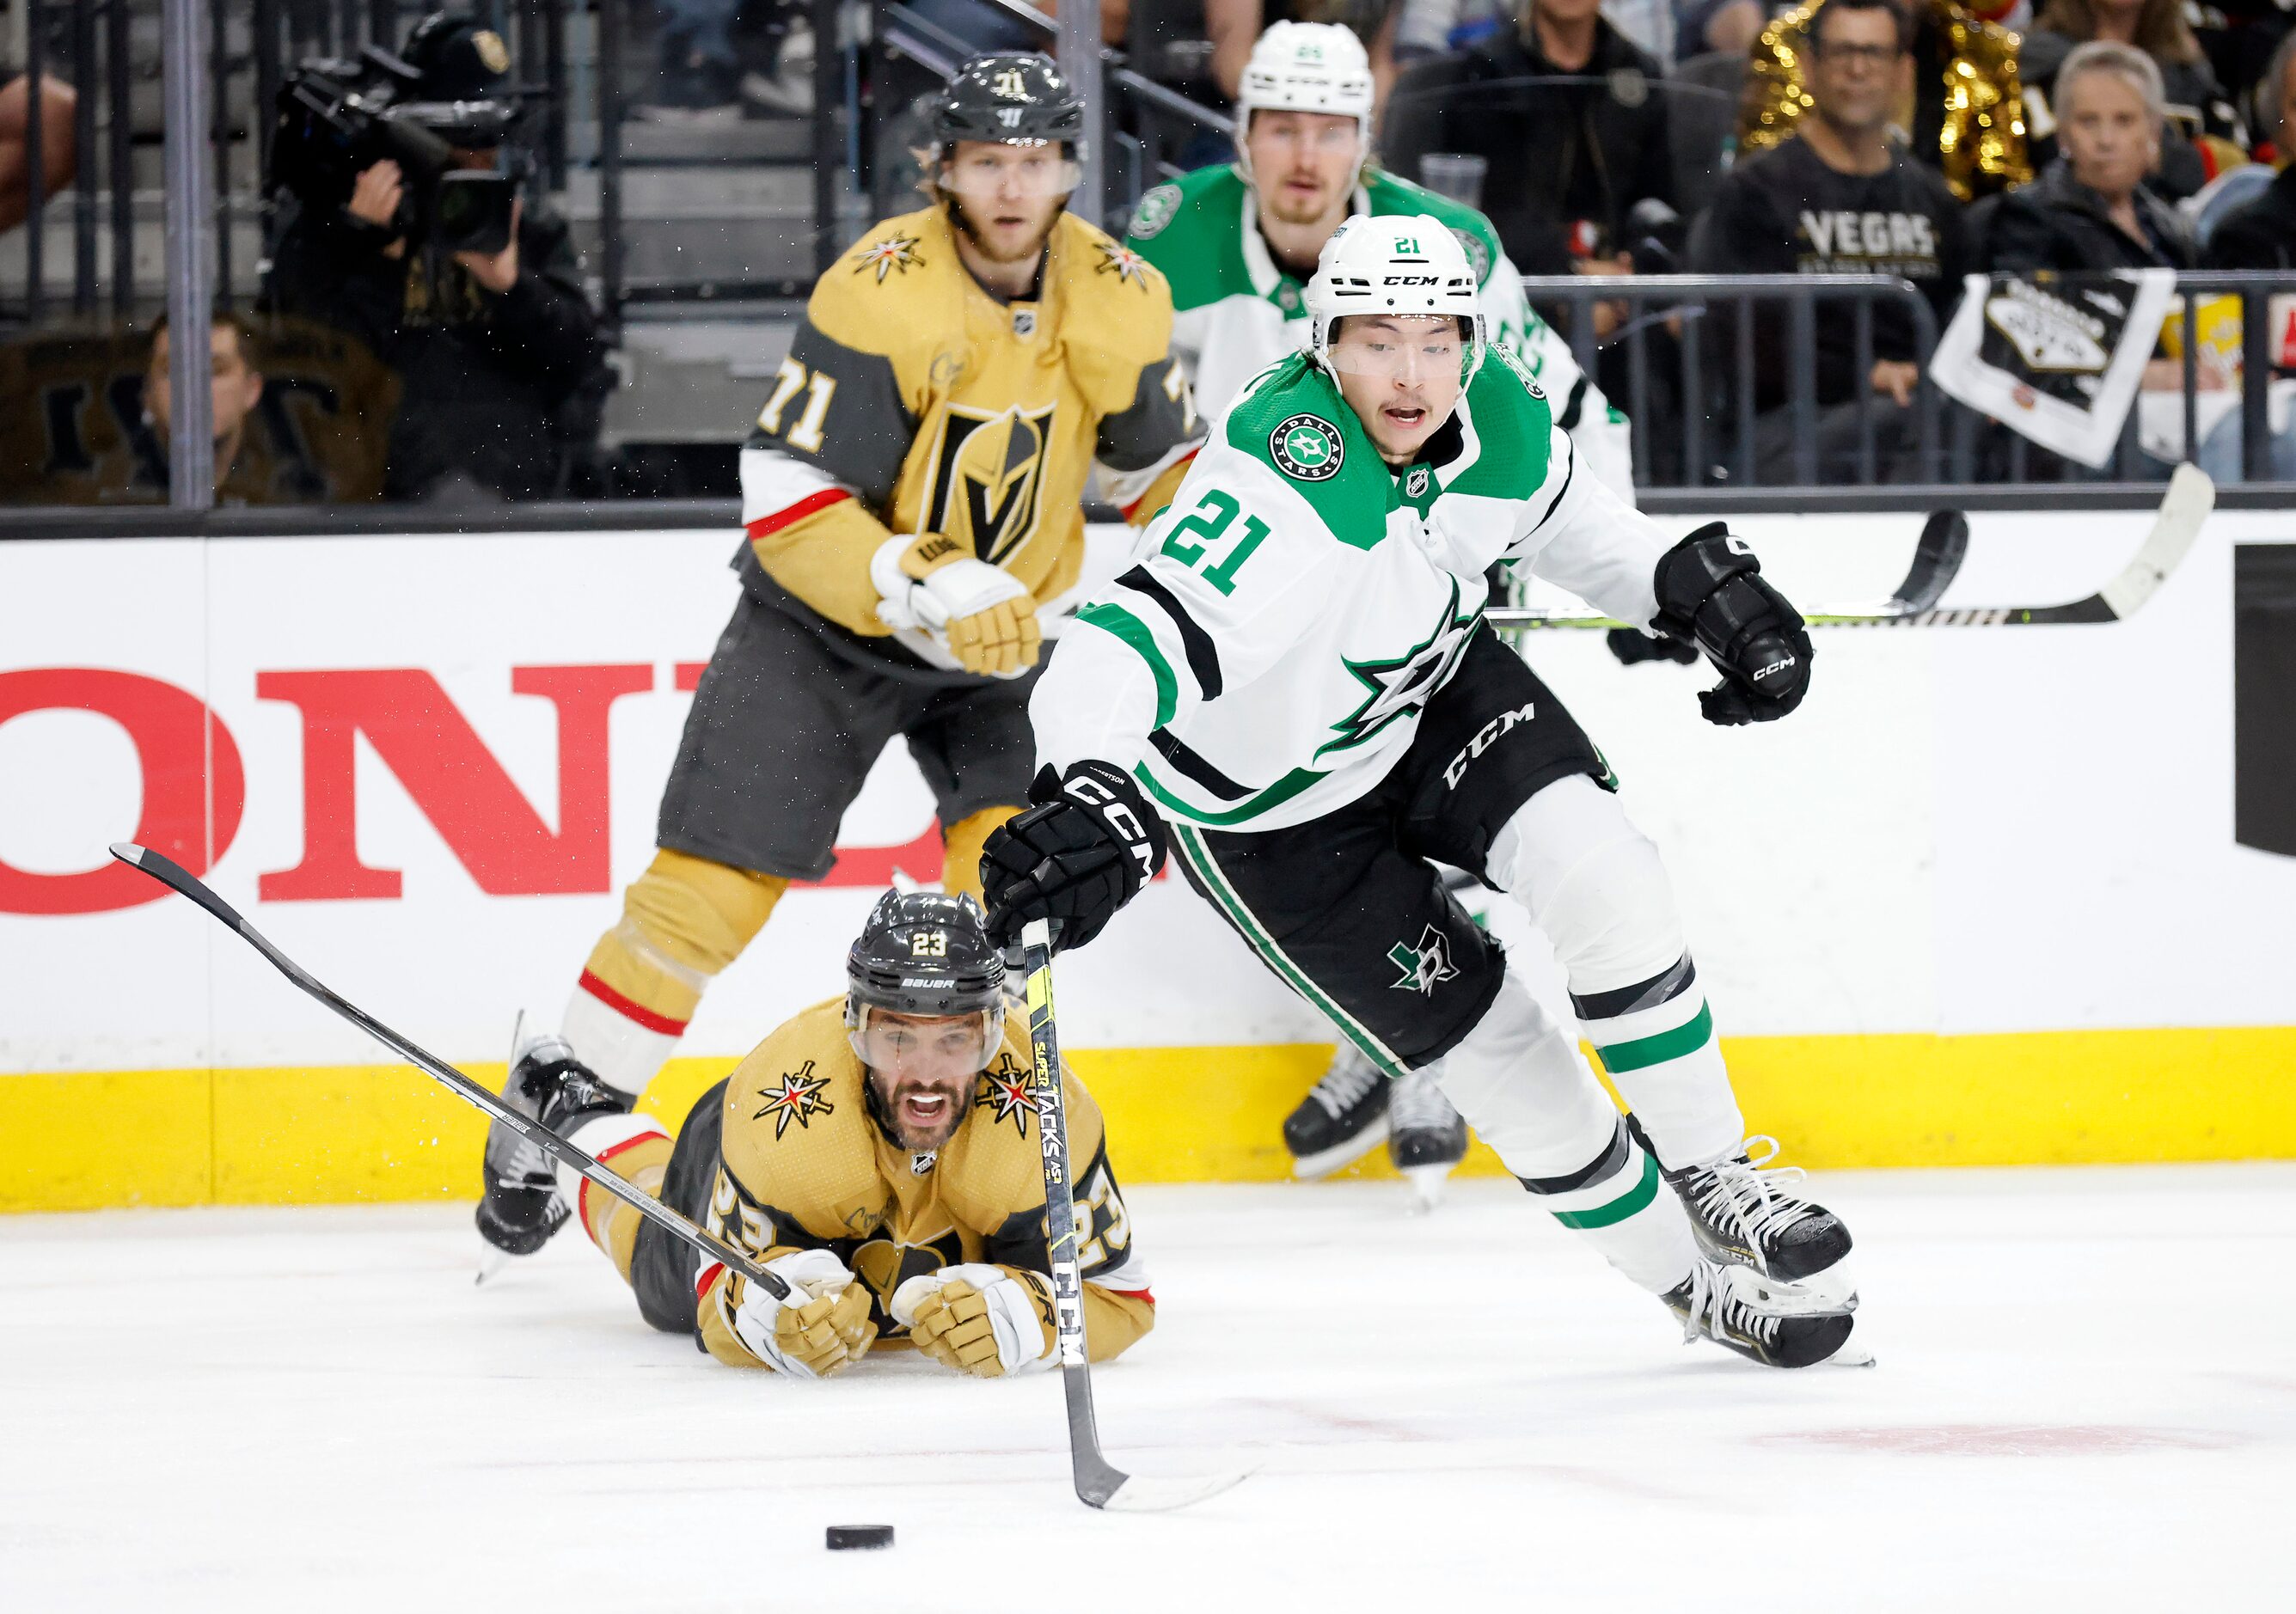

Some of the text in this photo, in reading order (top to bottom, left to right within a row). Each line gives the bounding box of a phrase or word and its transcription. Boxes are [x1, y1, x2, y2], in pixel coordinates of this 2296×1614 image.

[994, 71, 1026, 95] 71
[1393, 237, 1421, 254] 21
[1799, 210, 1936, 257] VEGAS
[1383, 276, 1439, 286] CCM
[756, 353, 838, 455] 71
[1274, 436, 1322, 478] STARS
[1287, 418, 1340, 466] DALLAS
[1160, 488, 1271, 598] 21
[1753, 656, 1796, 682] CCM
[1442, 702, 1535, 791] CCM
[1063, 775, 1154, 890] CCM
[912, 932, 947, 957] 23
[902, 978, 955, 989] BAUER
[1034, 1042, 1051, 1088] SUPER
[501, 1114, 528, 1133] BAUER
[1037, 1083, 1065, 1159] TACKS
[1718, 1247, 1755, 1267] CCM
